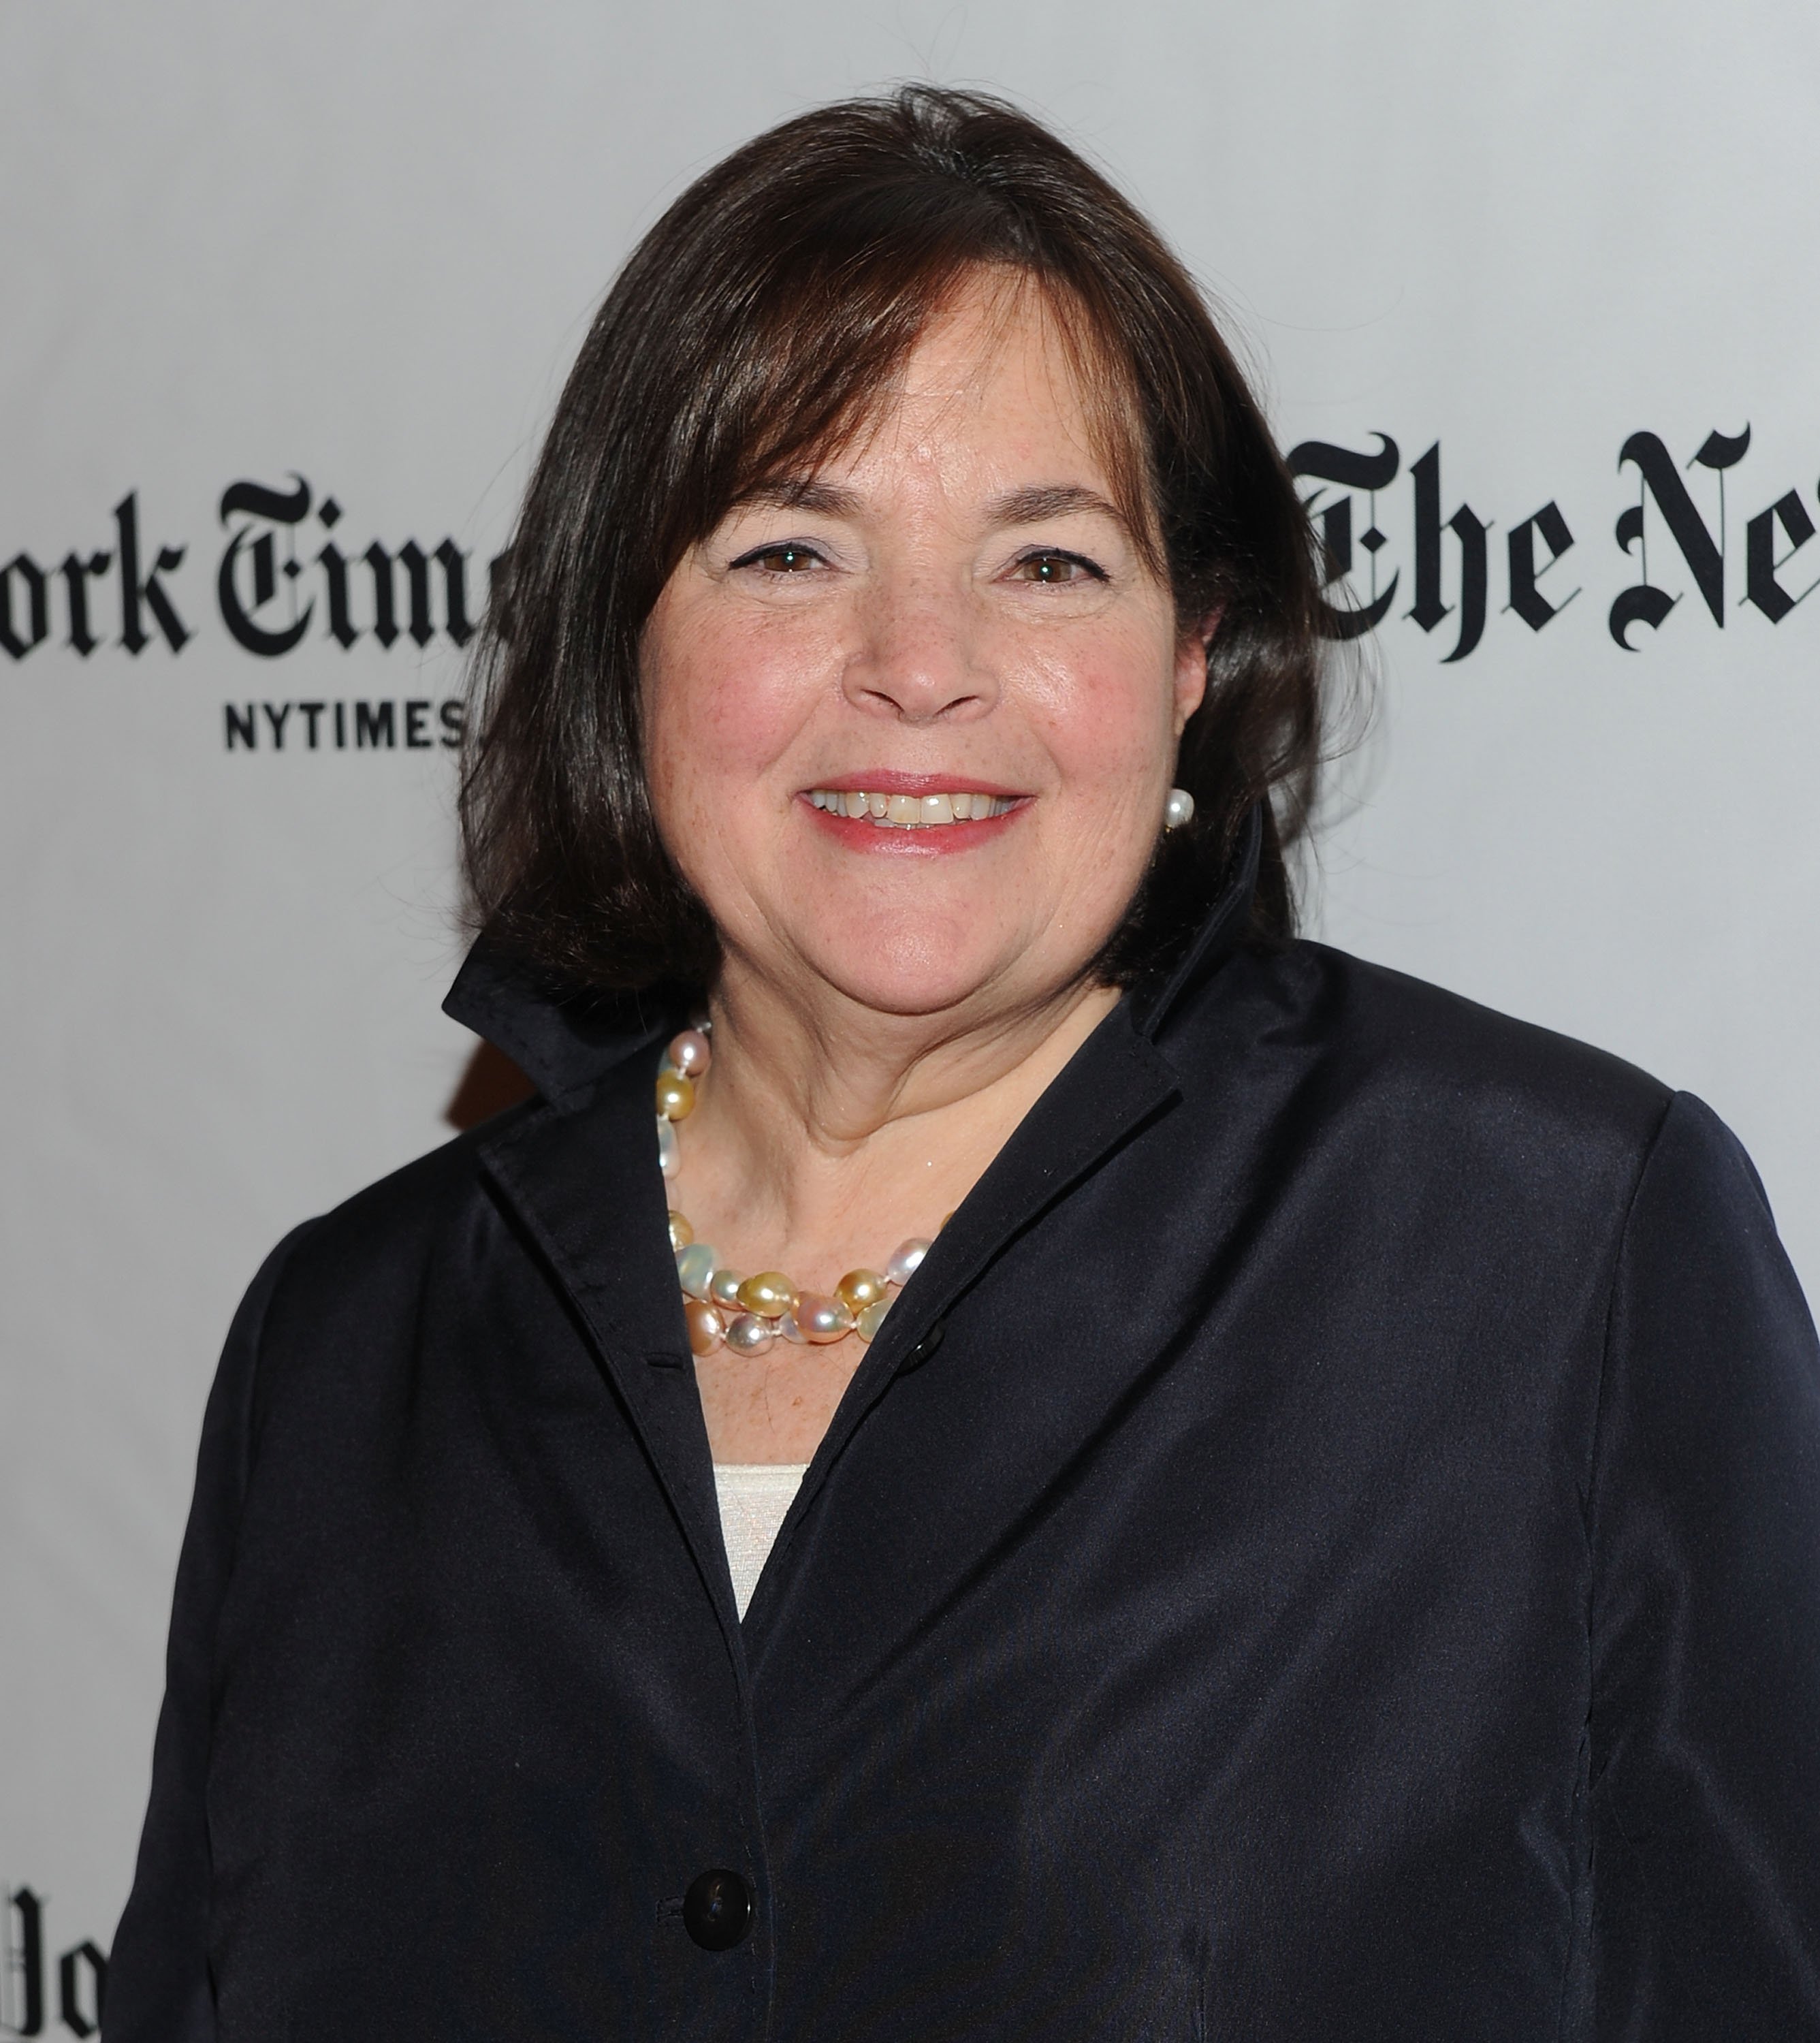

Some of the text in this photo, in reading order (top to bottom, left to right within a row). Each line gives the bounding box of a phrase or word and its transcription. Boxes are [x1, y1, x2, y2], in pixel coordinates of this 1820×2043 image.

[216, 472, 516, 658] Tim
[1286, 422, 1820, 663] The Ne
